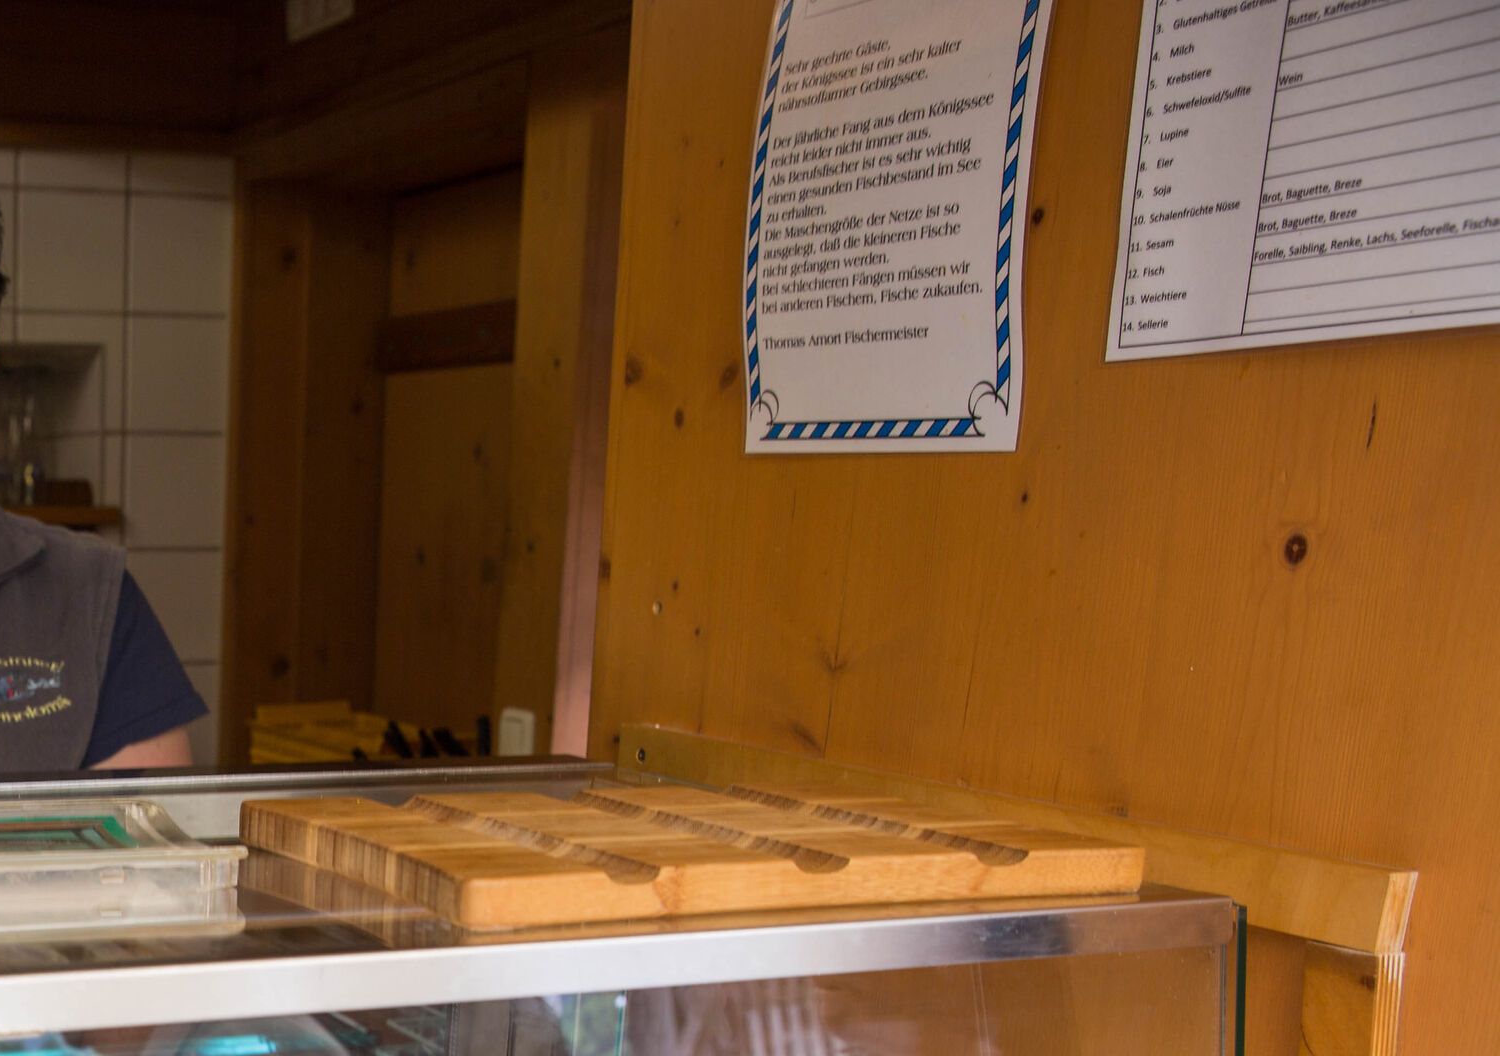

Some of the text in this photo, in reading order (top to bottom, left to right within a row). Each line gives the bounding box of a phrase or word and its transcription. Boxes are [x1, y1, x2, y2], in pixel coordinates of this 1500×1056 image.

[1156, 25, 1164, 34] 3.
[1173, 6, 1237, 30] Glutenhaltiges
[1286, 11, 1320, 28] Butter,
[786, 41, 890, 74] Sehr geehrte Gäste,
[1153, 44, 1194, 62] 4. Milch
[781, 41, 961, 93] der Königssee ist ein sehr kalter
[1150, 69, 1211, 89] 5. Krebstiere
[779, 70, 927, 112] nährstoffarmer Gebirgssee.
[1277, 74, 1303, 88] Wein
[1147, 87, 1251, 117] 6. Schwefeloxid/Sulfite
[773, 94, 994, 150] Der jährliche Fang aus dem Königssee
[771, 128, 931, 168] reicht leider nicht immer aus.
[1144, 129, 1189, 144] 7. Lupine
[769, 139, 971, 187] Als Berufsfischer ist es sehr wichtig
[1141, 159, 1173, 172] 8. Eier
[767, 159, 981, 204] einen gesunden Fischbestand im See
[1137, 185, 1171, 199] 9. Soja
[1260, 179, 1362, 207] Brot, Baguette, Breze
[765, 204, 959, 241] Die Maschengröße der Netze ist so
[766, 205, 826, 224] zu erhalten.
[1134, 201, 1240, 225] 10. Schalenfrüchte Nüsse
[1256, 210, 1357, 236] Brot, Baguette, Breze
[764, 222, 960, 259] ausgelegt, daß die kleineren Fische
[1131, 240, 1174, 252] 11. Sesam
[1253, 248, 1285, 261] Forelle,
[1289, 243, 1327, 256] Saibling,
[1330, 237, 1362, 254] Renke,
[1364, 232, 1397, 249] Lachs,
[763, 252, 888, 278] nicht gefangen werden.
[1128, 266, 1164, 281] 12. Fisch
[763, 261, 970, 296] Bei schlechteren Fängen müssen wir
[762, 302, 777, 314] bei
[780, 299, 823, 311] anderen
[881, 287, 918, 302] Fische
[923, 281, 982, 298] zukaufen.
[1126, 292, 1186, 305] 13. Weichtiere
[763, 328, 928, 349] Thomas Amort Fischermeister
[1123, 320, 1168, 332] 14. Sellerie
